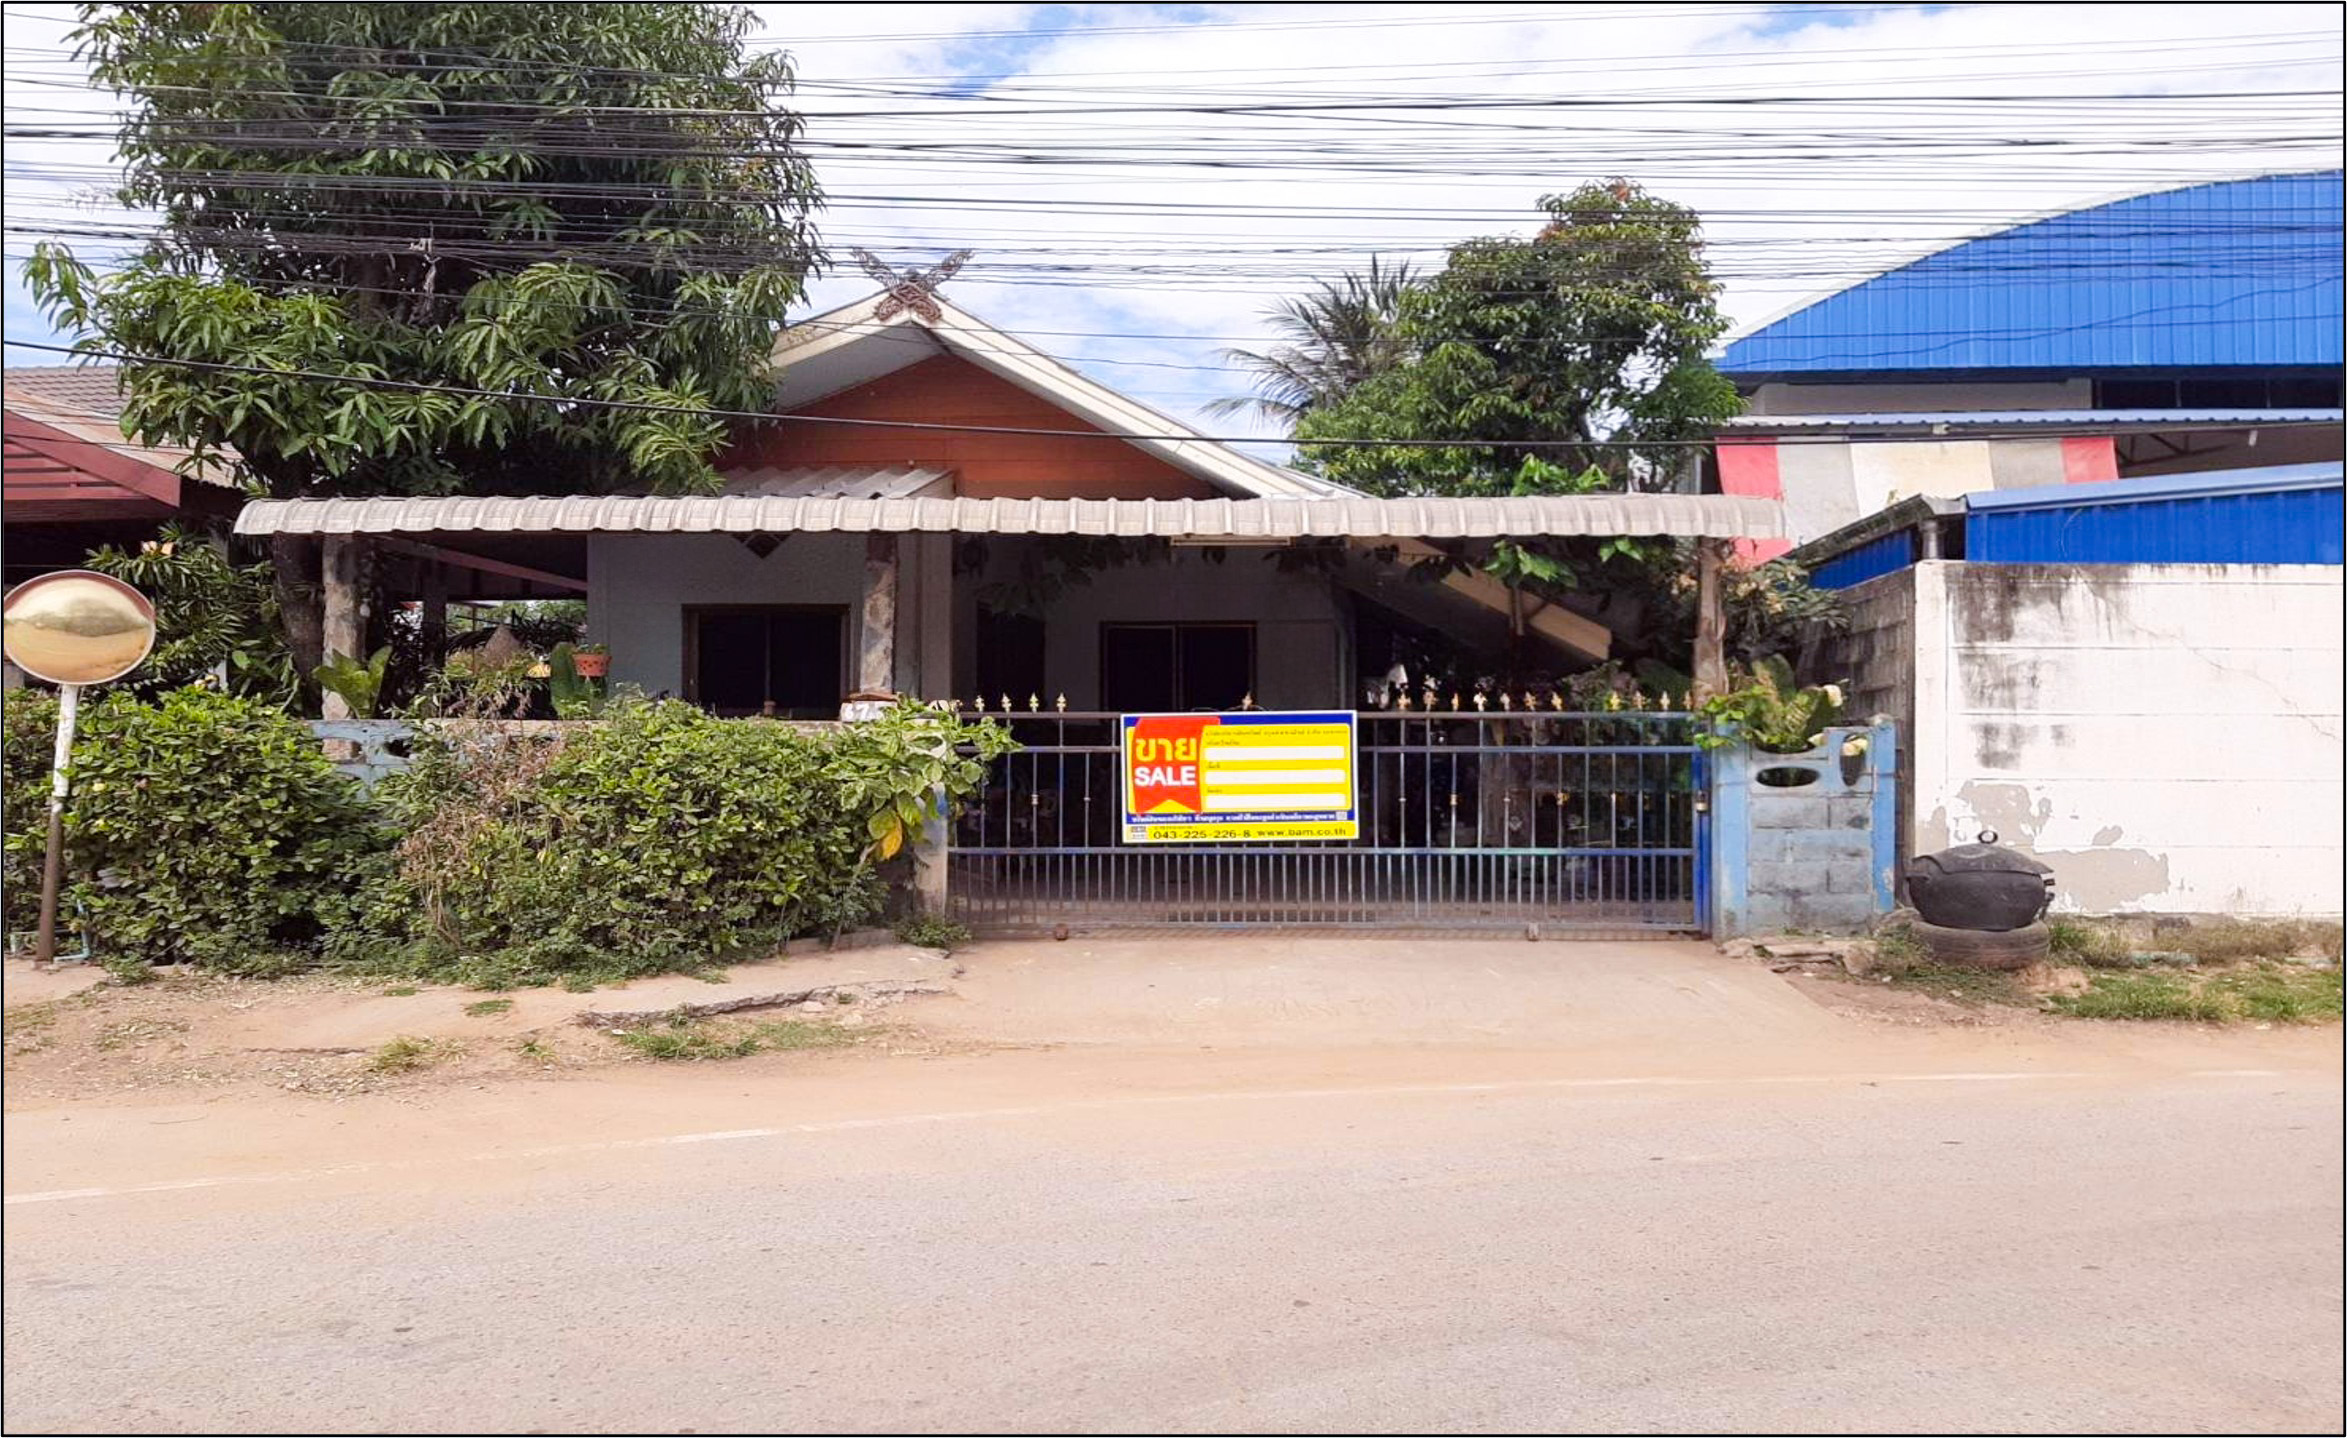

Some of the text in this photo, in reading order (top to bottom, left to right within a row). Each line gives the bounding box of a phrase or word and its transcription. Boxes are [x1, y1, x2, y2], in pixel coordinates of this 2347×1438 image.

[1135, 737, 1196, 762] ขาย
[1134, 766, 1196, 787] SALE
[1153, 828, 1251, 840] 043-225-226-8
[1256, 827, 1347, 838] www.bam.co.th
